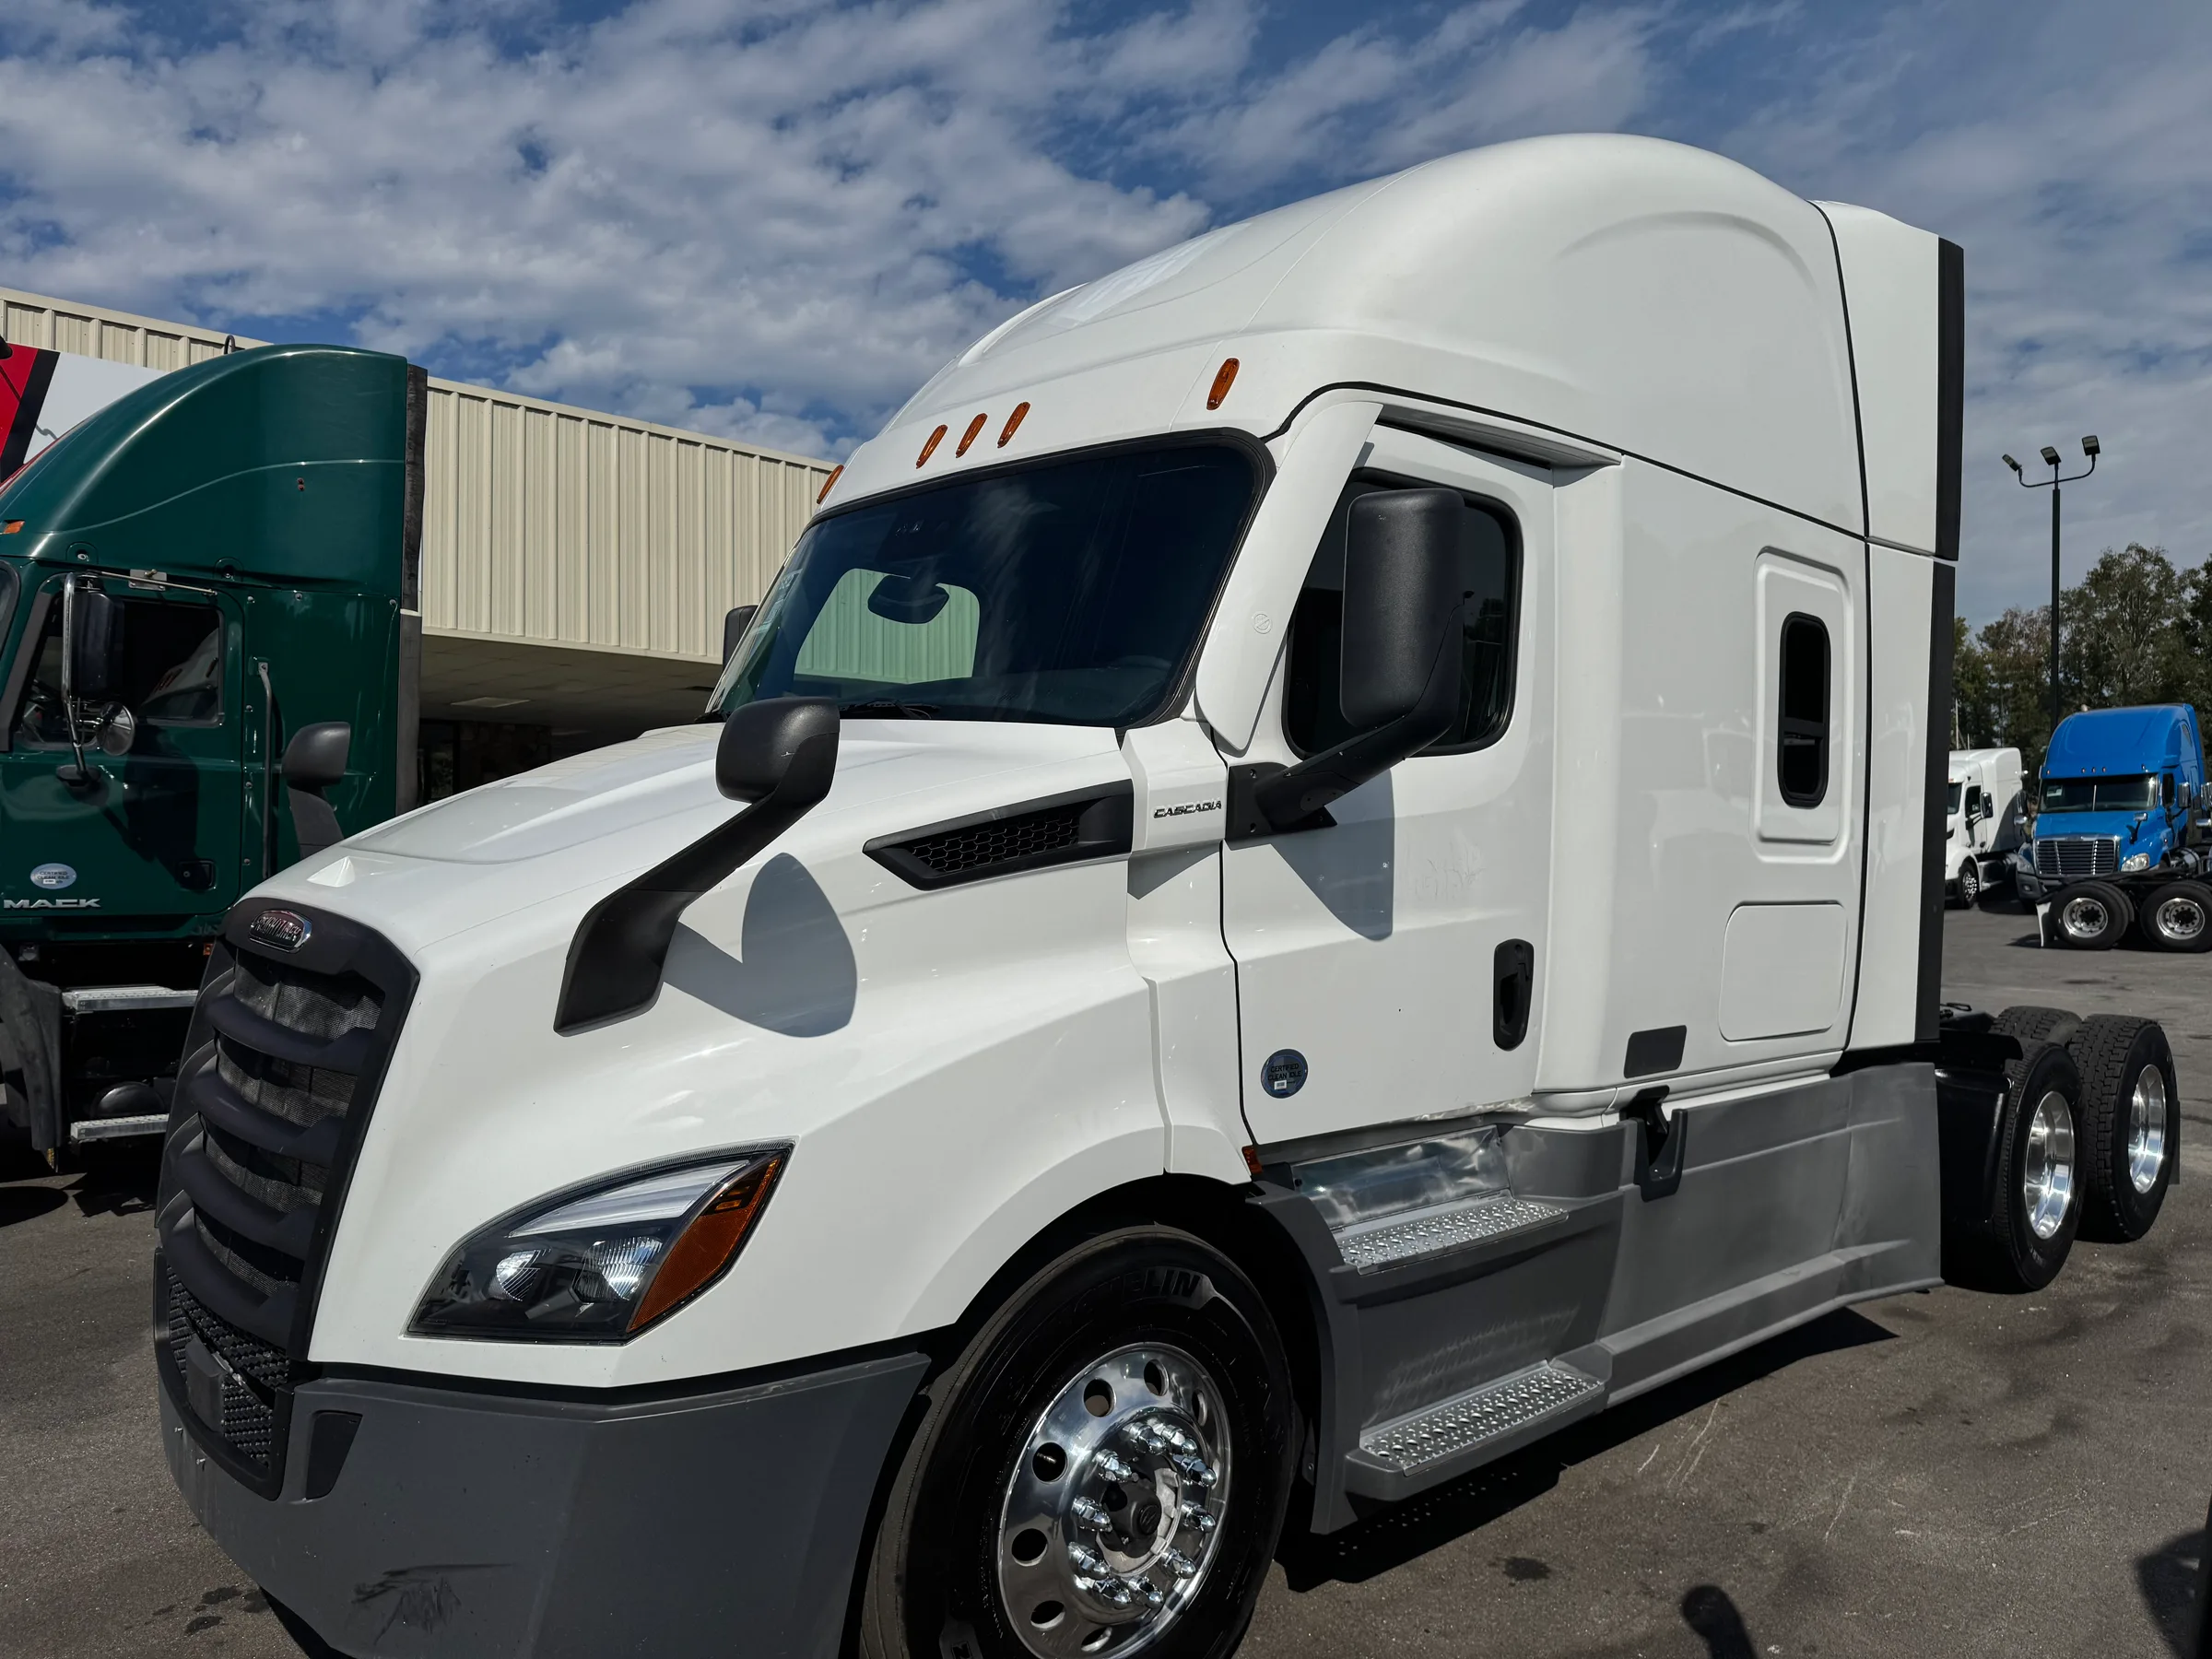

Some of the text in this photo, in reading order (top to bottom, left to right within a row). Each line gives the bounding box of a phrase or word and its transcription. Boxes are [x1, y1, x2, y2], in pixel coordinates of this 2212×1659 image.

[1154, 800, 1222, 818] CASCADIA
[4, 898, 101, 909] MACK
[1271, 1064, 1299, 1072] CERTIFIED
